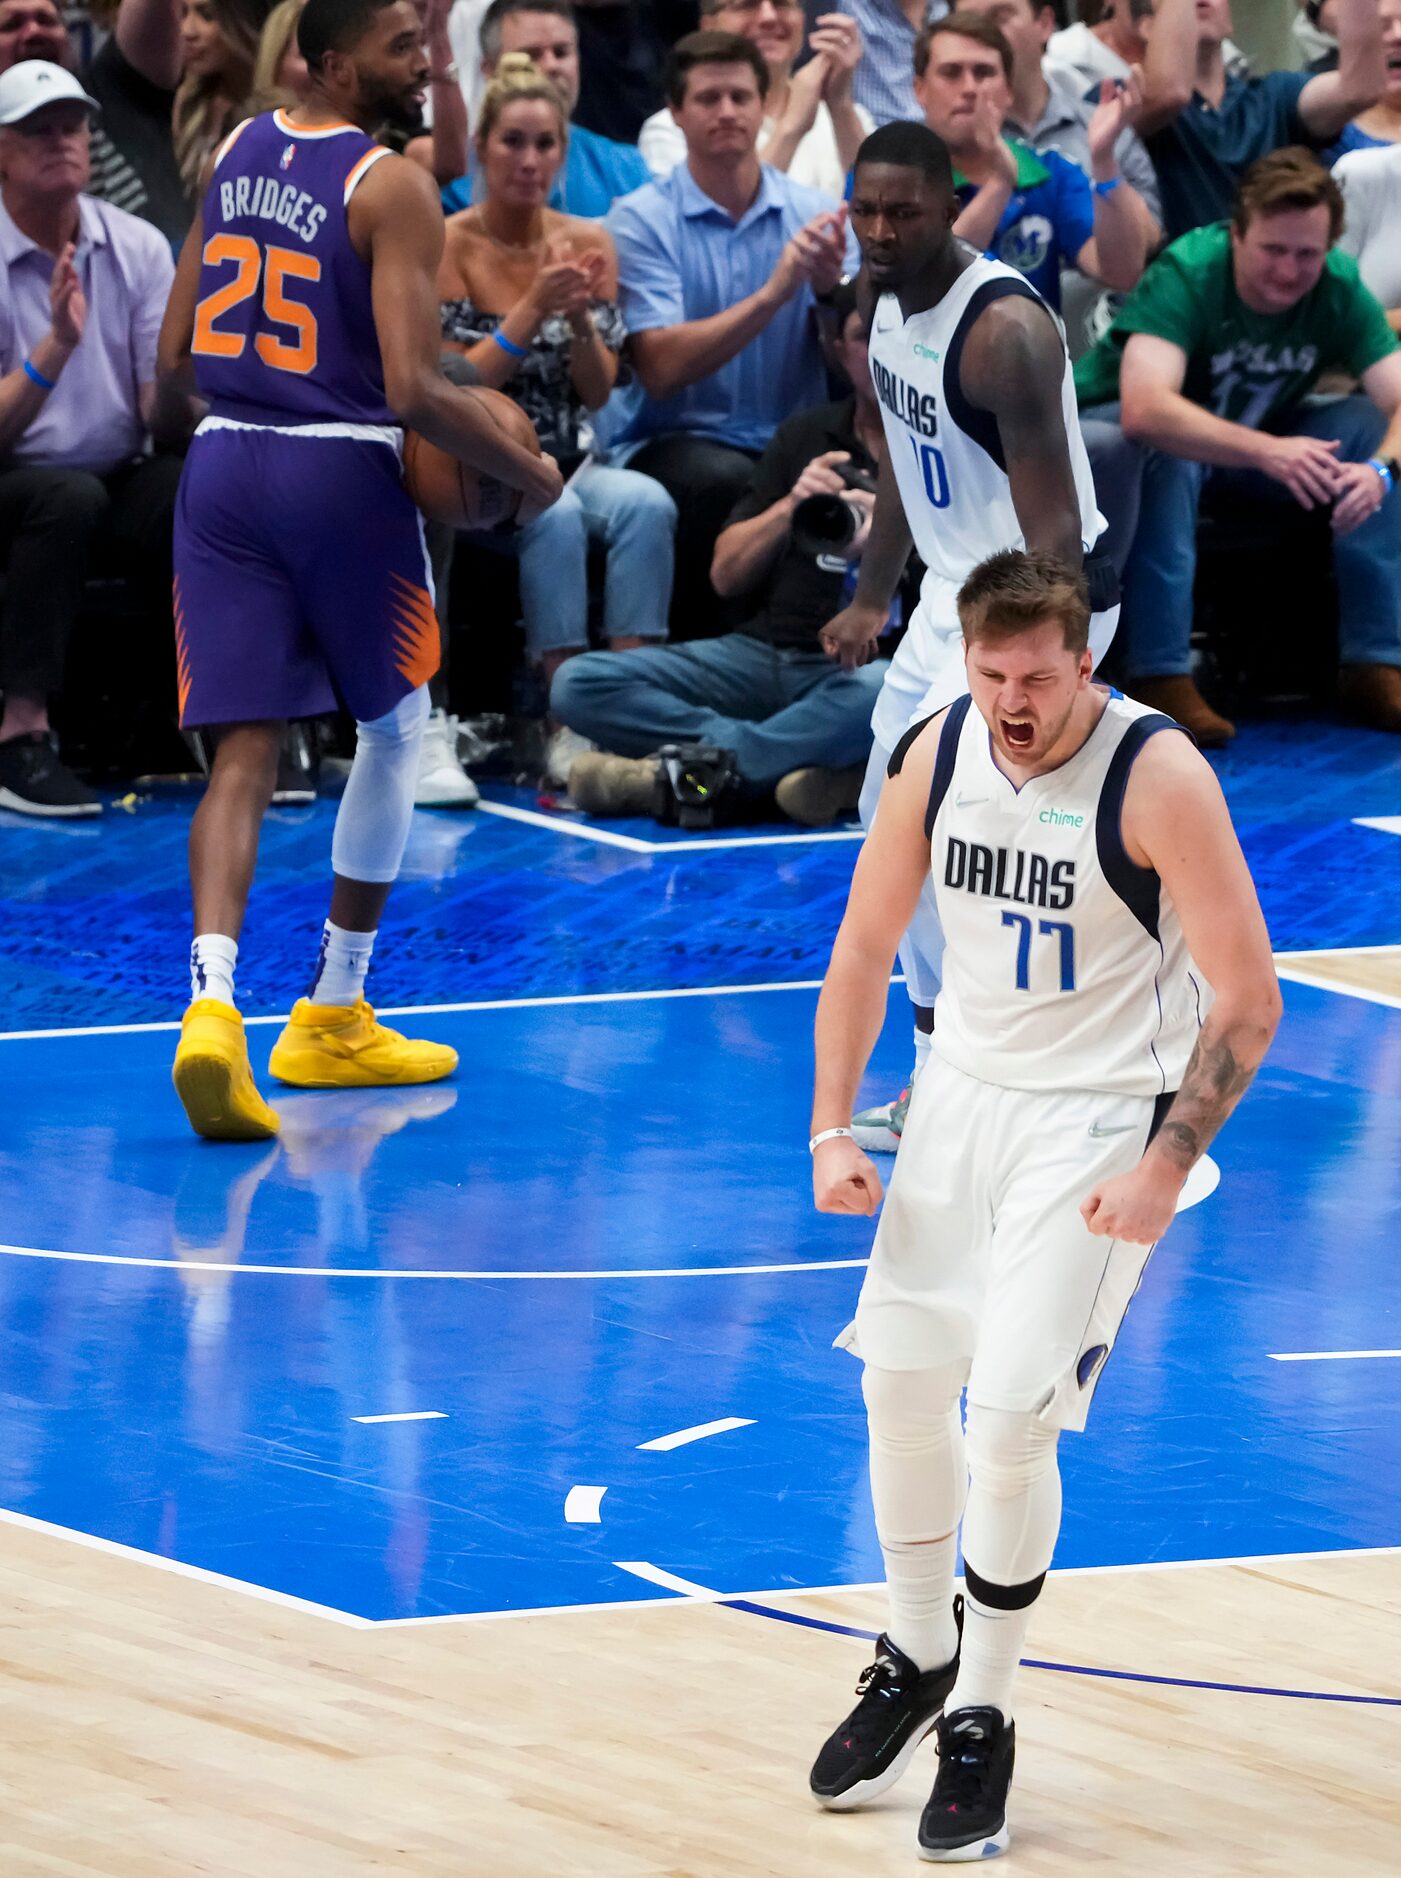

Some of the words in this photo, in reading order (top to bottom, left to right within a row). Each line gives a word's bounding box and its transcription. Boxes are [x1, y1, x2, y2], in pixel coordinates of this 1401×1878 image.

[220, 176, 327, 243] BRIDGES
[191, 233, 321, 375] 25
[872, 356, 938, 438] DALLAS
[1039, 808, 1084, 828] chime
[943, 834, 1078, 911] DALLAS
[1001, 909, 1077, 993] 77
